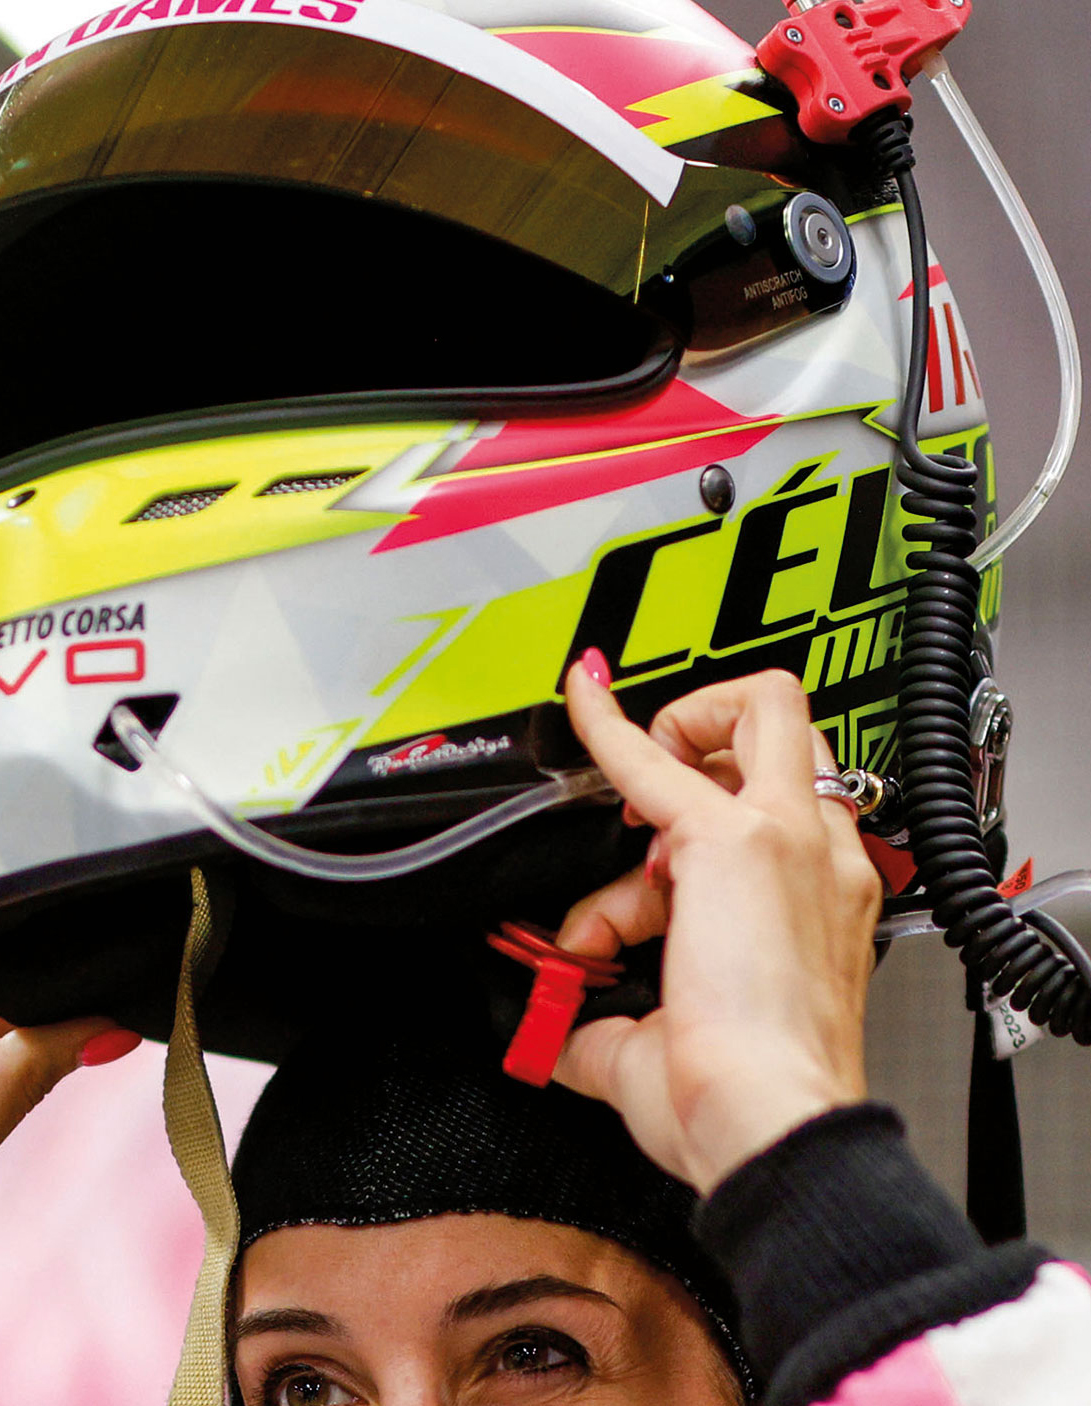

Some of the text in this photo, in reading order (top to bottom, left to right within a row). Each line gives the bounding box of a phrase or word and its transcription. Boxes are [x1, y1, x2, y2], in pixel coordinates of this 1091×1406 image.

[743, 268, 804, 301] ANTISCRATCH
[771, 286, 808, 310] ANTIFOG
[61, 602, 146, 637] CORSA
